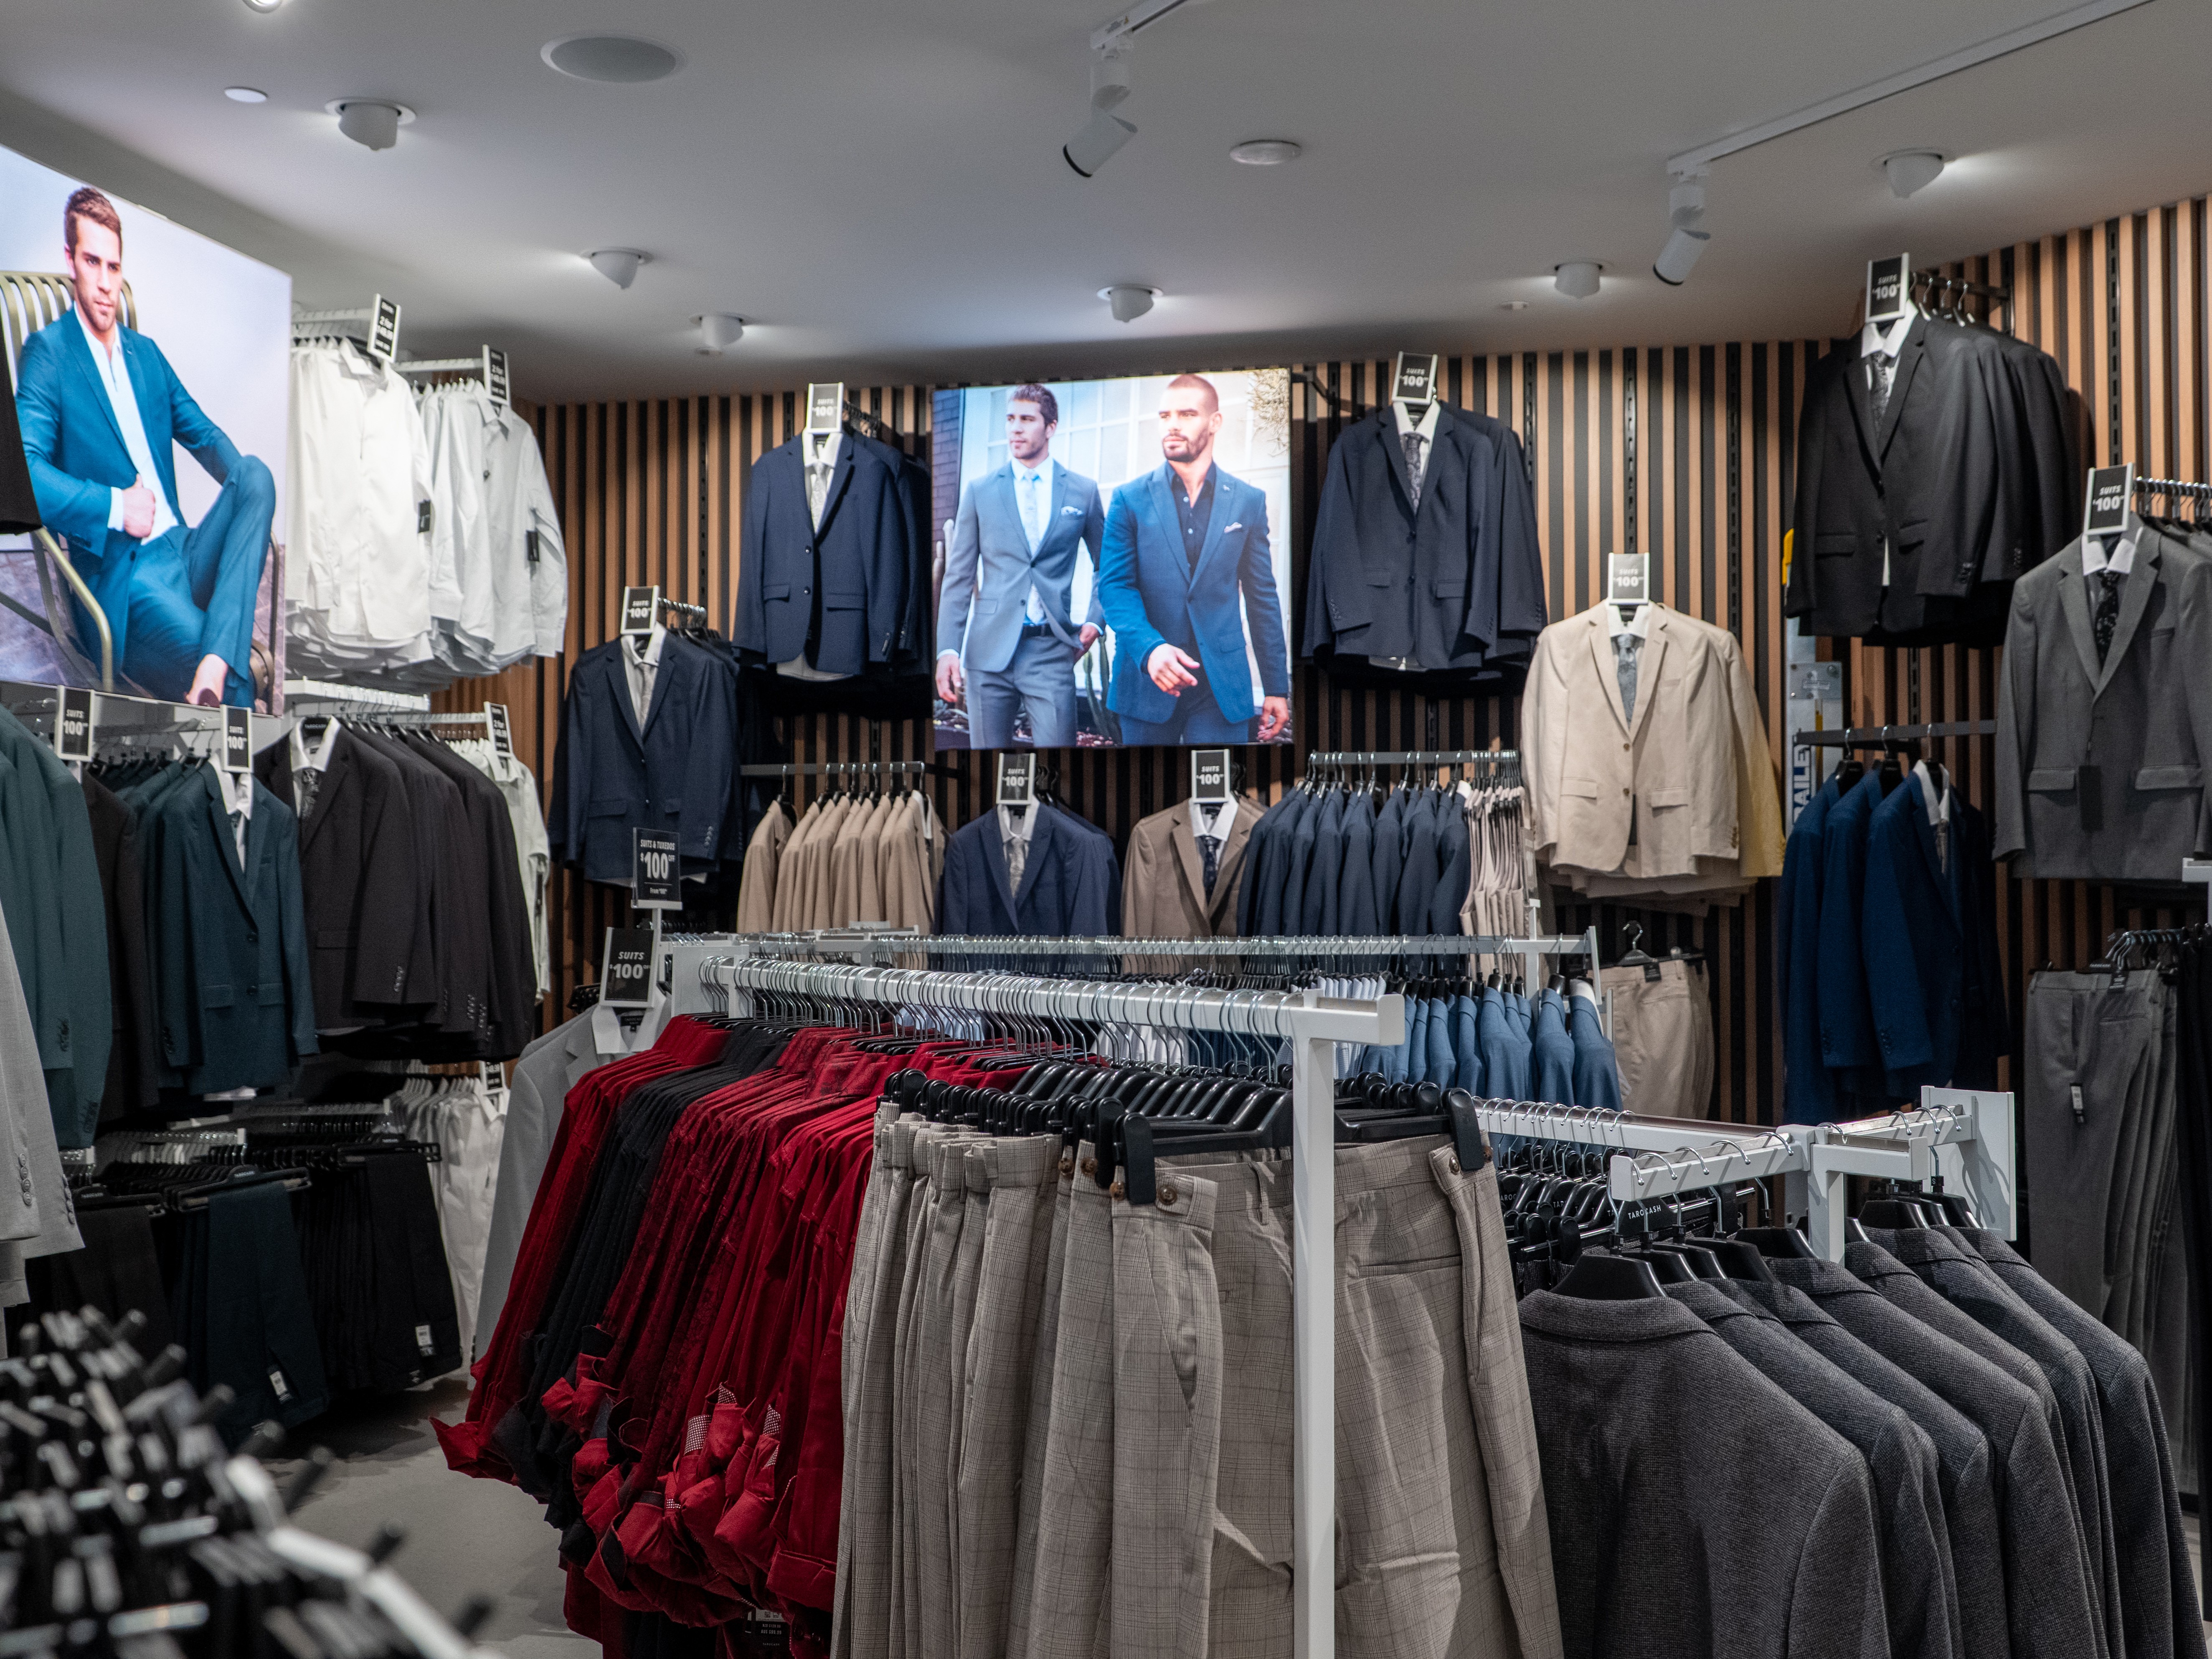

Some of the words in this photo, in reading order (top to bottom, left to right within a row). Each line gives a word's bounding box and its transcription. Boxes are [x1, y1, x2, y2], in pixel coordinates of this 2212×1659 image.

[2099, 485, 2122, 496] SUITS
[228, 736, 244, 750] 100
[640, 839, 652, 848] SUITS
[652, 840, 656, 849] &
[657, 841, 675, 851] TUXEDOS
[618, 951, 644, 960] SUITS
